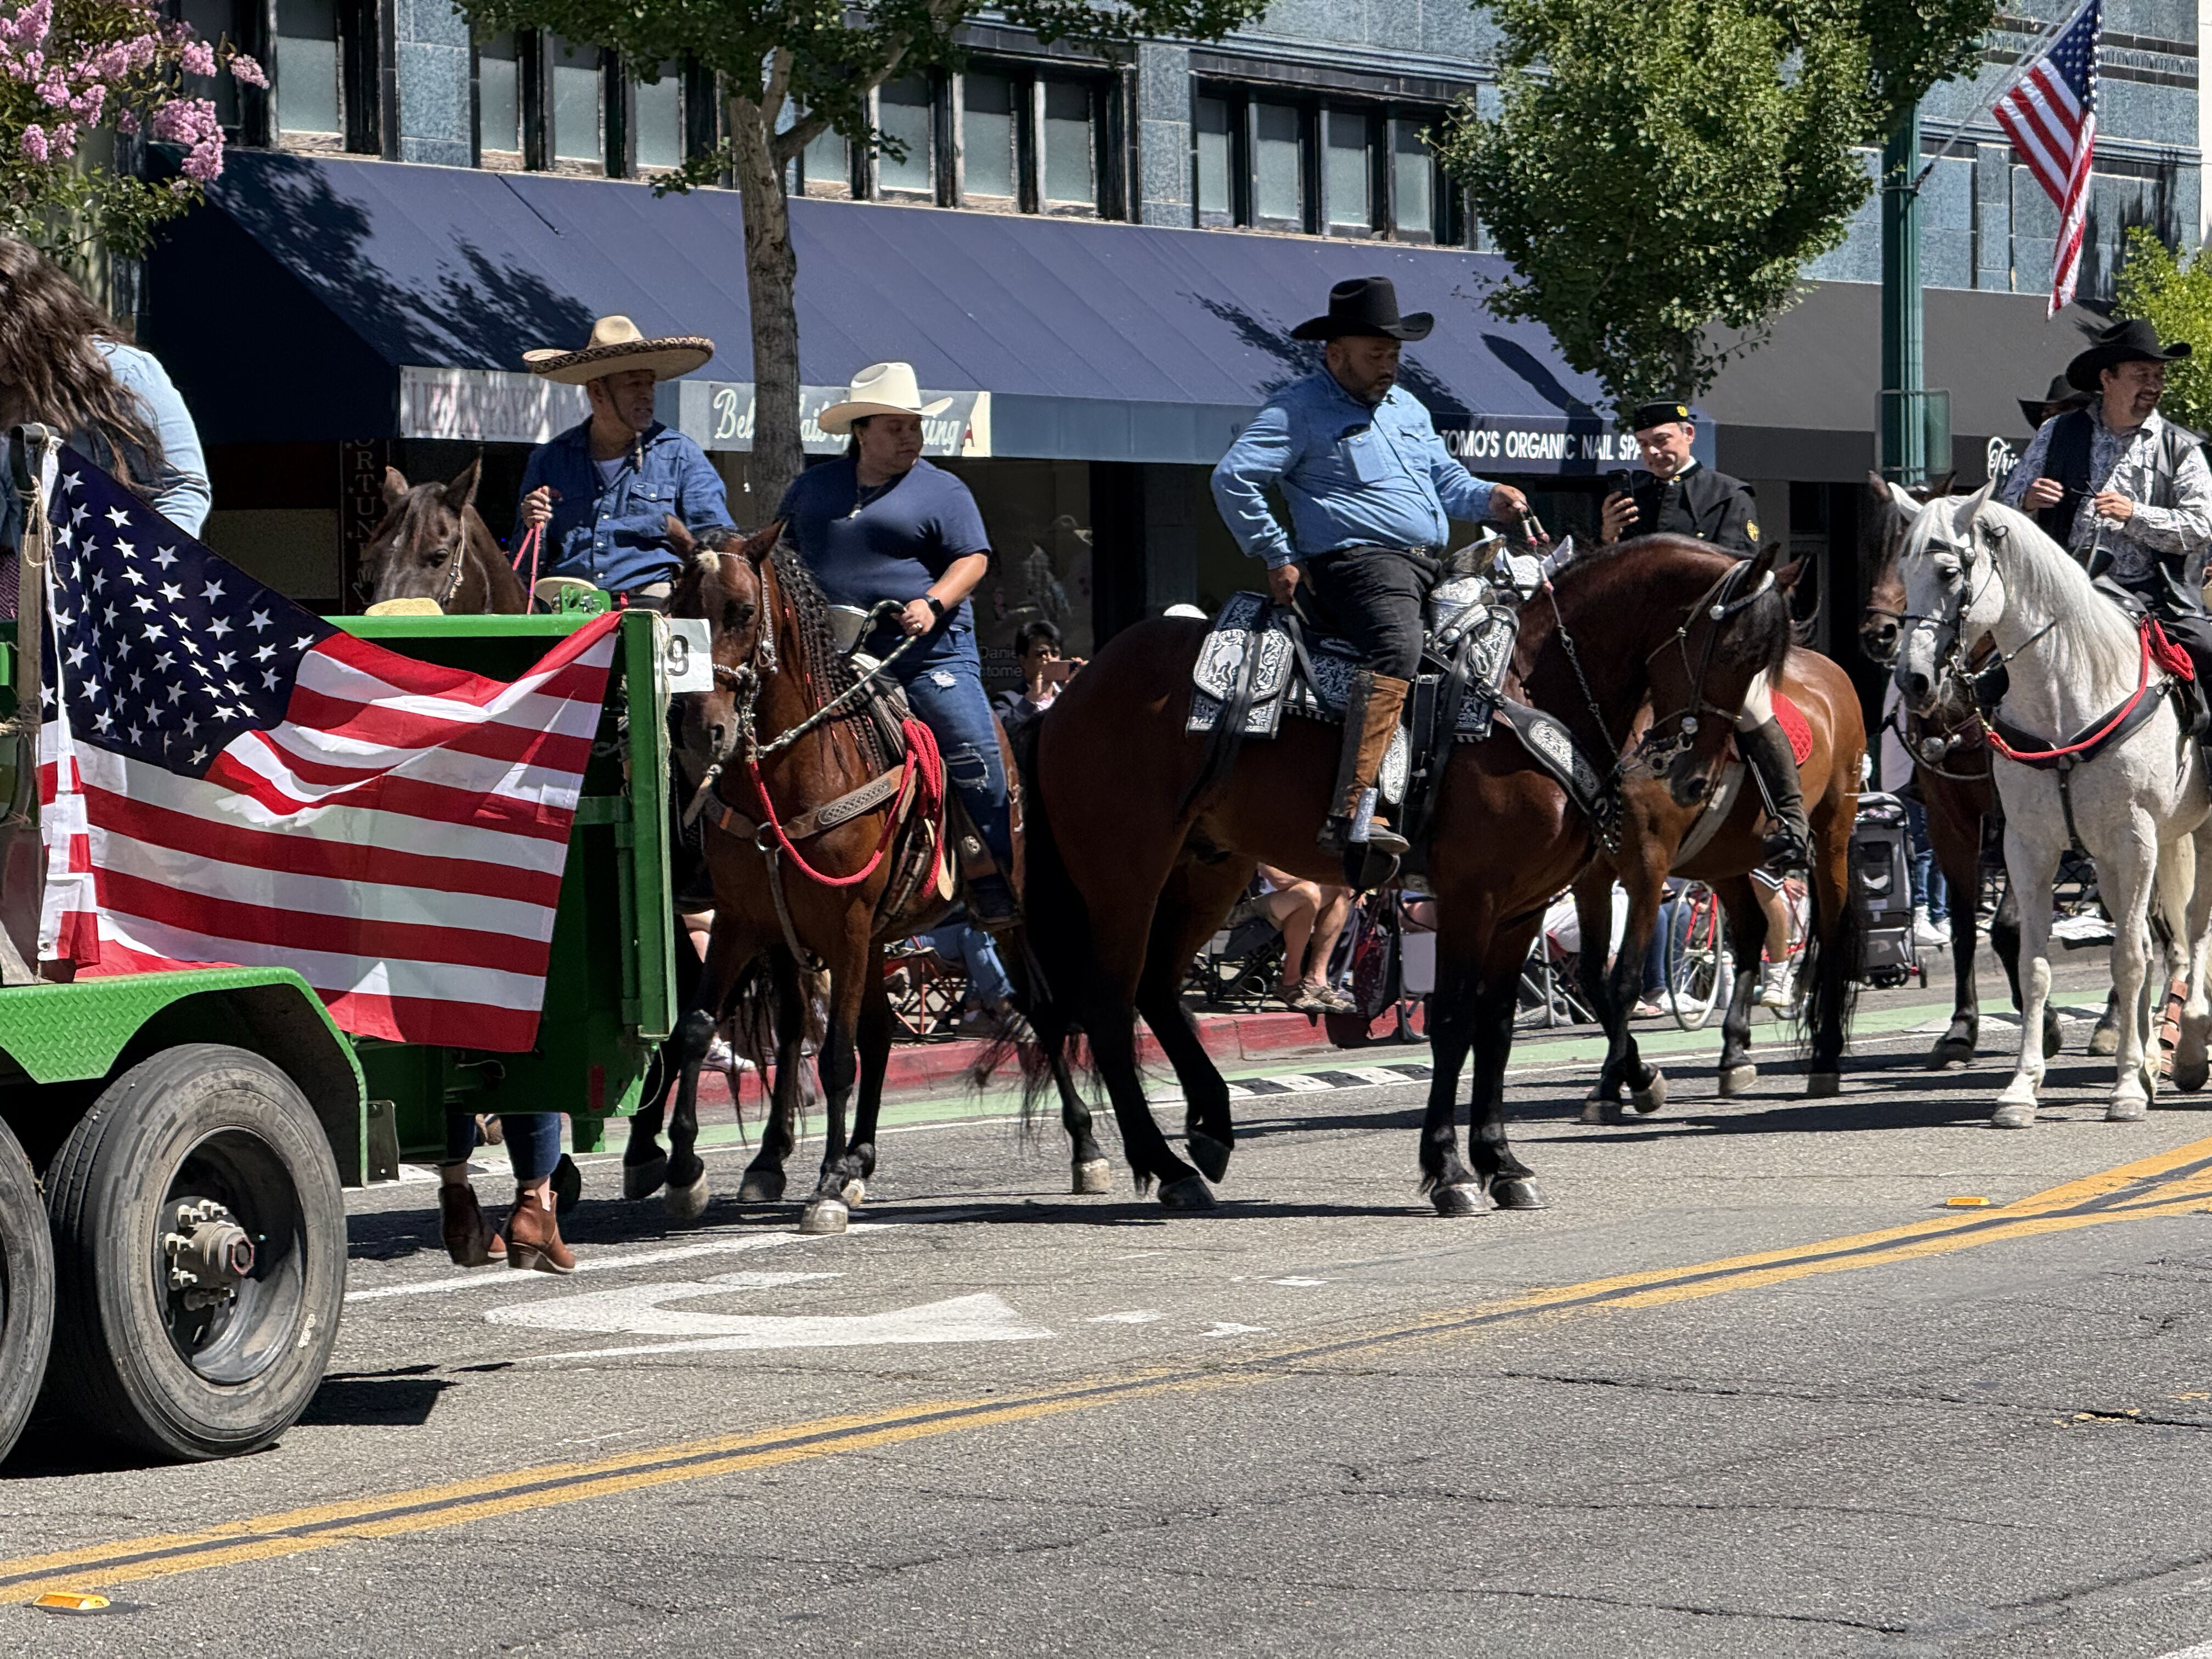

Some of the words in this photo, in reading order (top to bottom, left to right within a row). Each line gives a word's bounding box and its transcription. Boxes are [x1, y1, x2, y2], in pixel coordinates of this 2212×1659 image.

[714, 388, 756, 439] Bel
[1505, 431, 1576, 460] ORGANIC
[1581, 434, 1614, 460] NAIL
[667, 634, 690, 677] 9
[978, 646, 1017, 659] Danie
